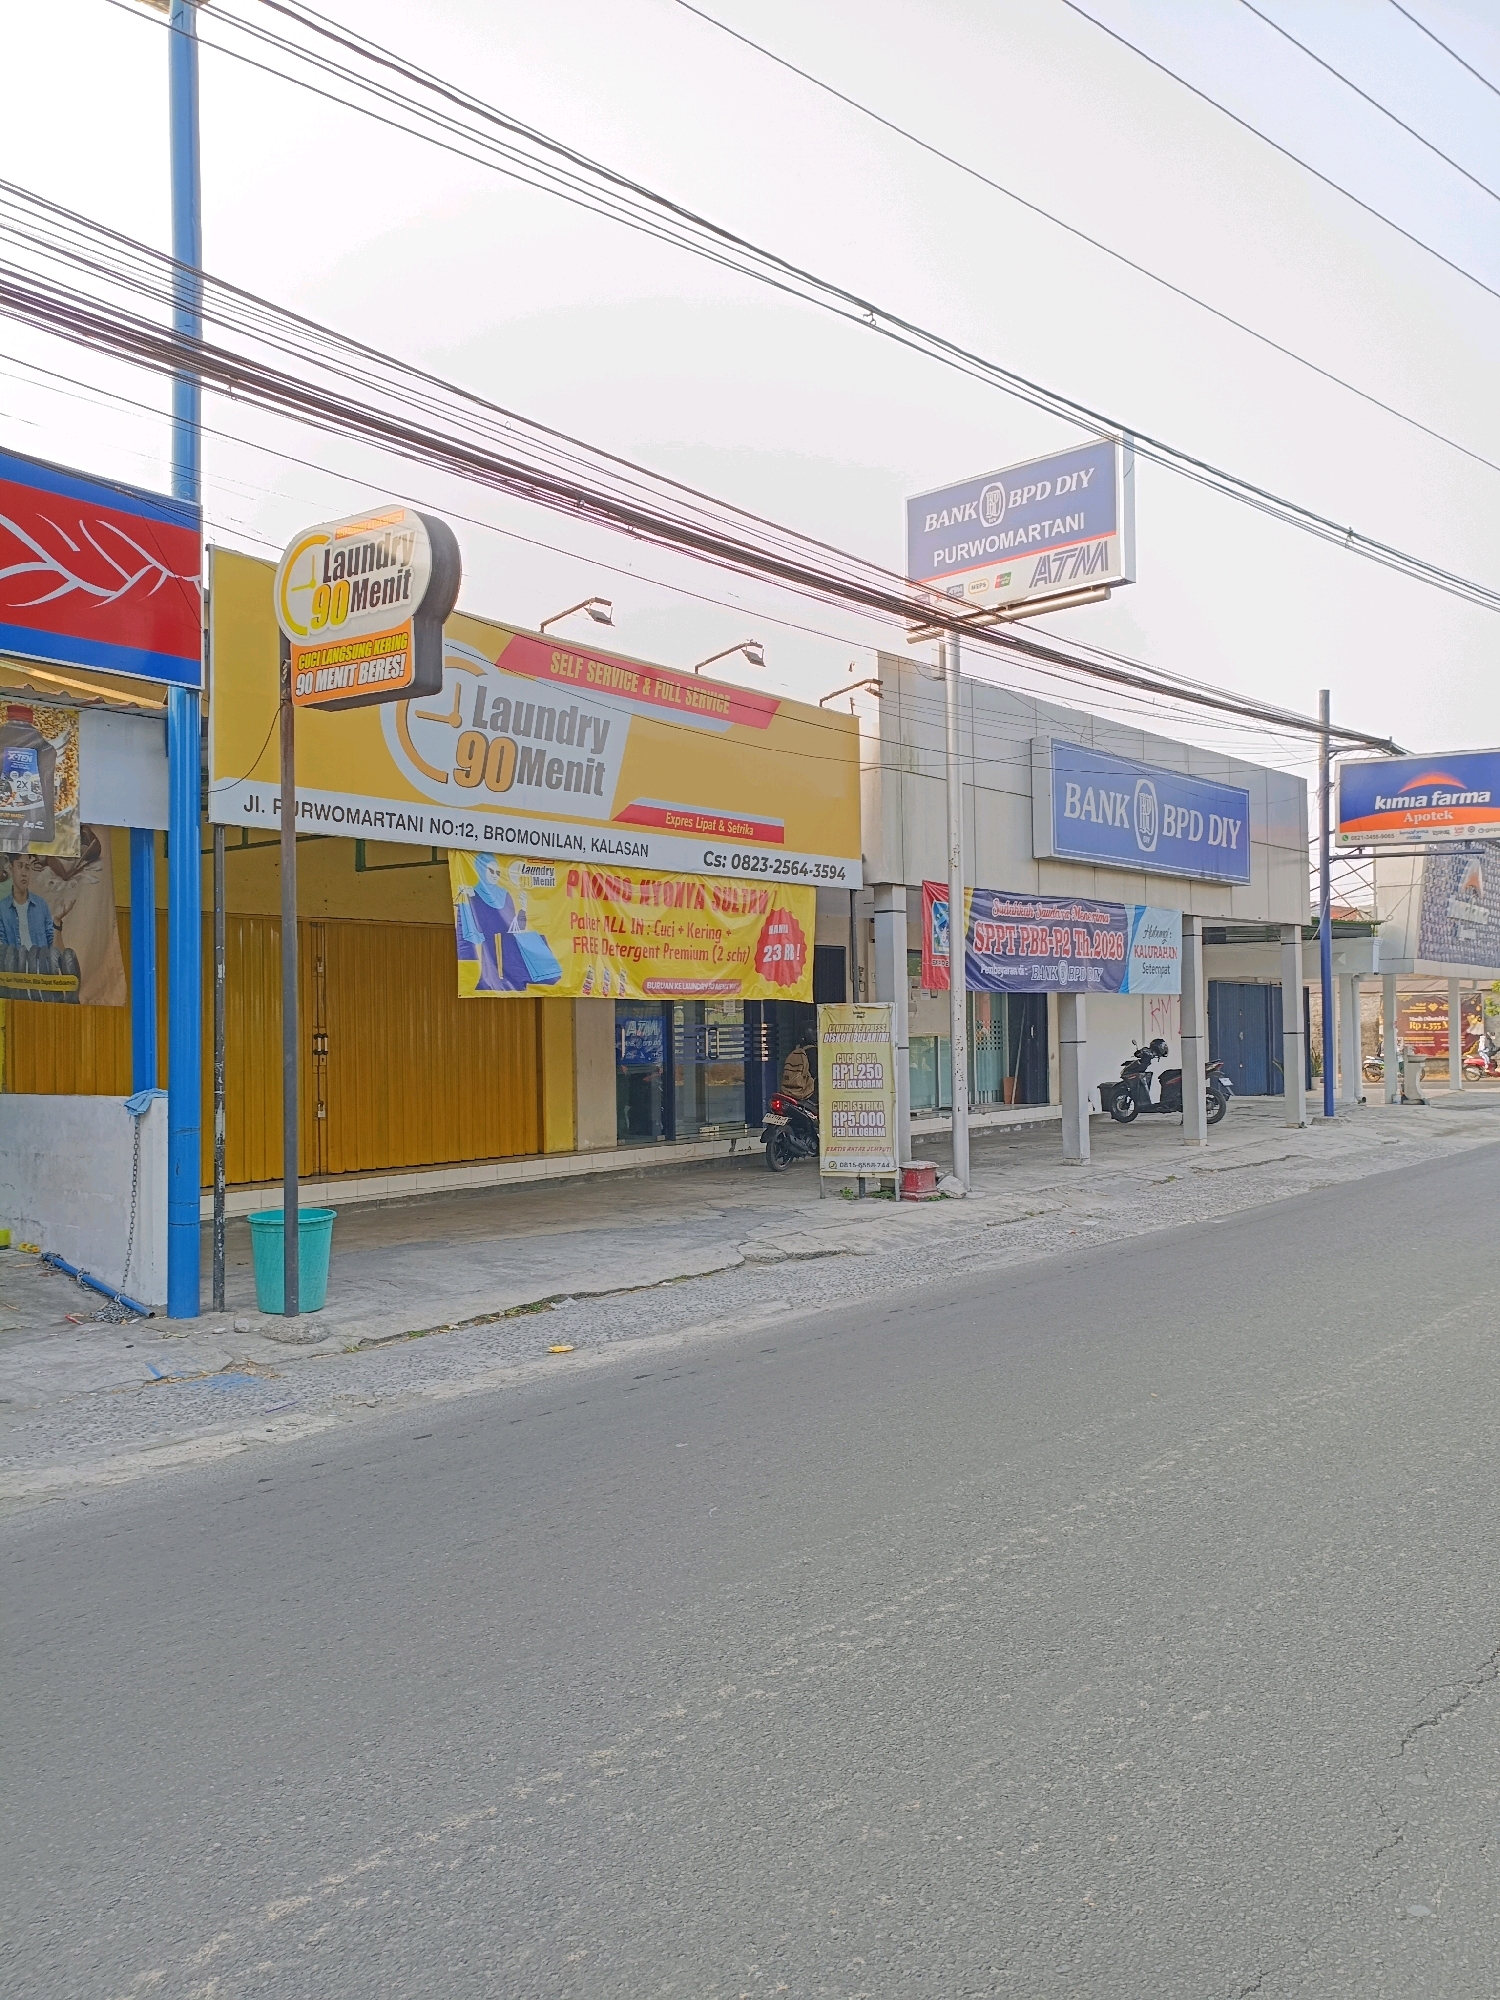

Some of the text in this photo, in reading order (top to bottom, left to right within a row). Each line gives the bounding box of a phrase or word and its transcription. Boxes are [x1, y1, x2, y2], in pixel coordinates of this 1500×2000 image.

[924, 467, 1095, 533] BANK BPD DIY
[933, 512, 1085, 567] PURWOMARTANI
[322, 530, 417, 583] Laundry
[1029, 540, 1109, 588] ATM
[311, 568, 412, 630] 90 Menit
[298, 632, 408, 670] CUCI LANGSUNG KERING
[295, 652, 407, 697] 90 MENIT BERES!
[550, 652, 731, 714] SELF SERVICE & FULL SERVICE
[472, 685, 611, 755] Laundry
[453, 730, 606, 796] 90 Menit
[16, 780, 28, 790] 2X
[1375, 791, 1491, 810] kimia farma
[666, 812, 754, 836] Expres Lipat & Setrika
[1063, 782, 1241, 850] BANK BPD DIY
[1403, 810, 1454, 824] Apotek
[273, 798, 424, 832] PRWOMARTANI
[430, 818, 478, 841] NO:12,
[484, 825, 586, 853] BROMONILAN,
[591, 837, 649, 858] KALASAN
[521, 864, 554, 876] Laundry
[704, 850, 846, 880] Cs: 0823-2564-3594
[533, 876, 556, 887] Menit
[992, 898, 1034, 918] Sudahkah
[1071, 905, 1111, 924] Menerima
[604, 916, 626, 933] ALL
[631, 917, 644, 935] IN
[654, 920, 675, 937] Cuci
[687, 922, 722, 943] Kering
[973, 921, 1124, 960] SPPT PBB-P2 Th.2026
[573, 936, 750, 965] FREE Detergent Premium (2 scht)
[763, 944, 782, 963] 23
[1134, 945, 1178, 959] KALURAHAN
[1031, 965, 1058, 980] BANK
[1068, 966, 1086, 982] BPD
[1142, 962, 1170, 978] Setempat
[646, 981, 674, 990] BURUAN
[674, 982, 682, 990] KE
[683, 982, 709, 990] LAUNDRY
[626, 1020, 658, 1036] ATM
[828, 1024, 886, 1032] LAUNDRY EXPRESS
[1409, 1021, 1421, 1030] Rp
[823, 1032, 890, 1042] DISKON BULAN INI
[836, 1053, 877, 1063] CUCI SAJA
[832, 1063, 883, 1080] RP1.250
[832, 1079, 883, 1089] PER KILOGRAM
[832, 1101, 884, 1111] CUCI SETRIKA
[832, 1111, 885, 1127] RP5.000
[832, 1127, 886, 1137] PER KILOGRAM
